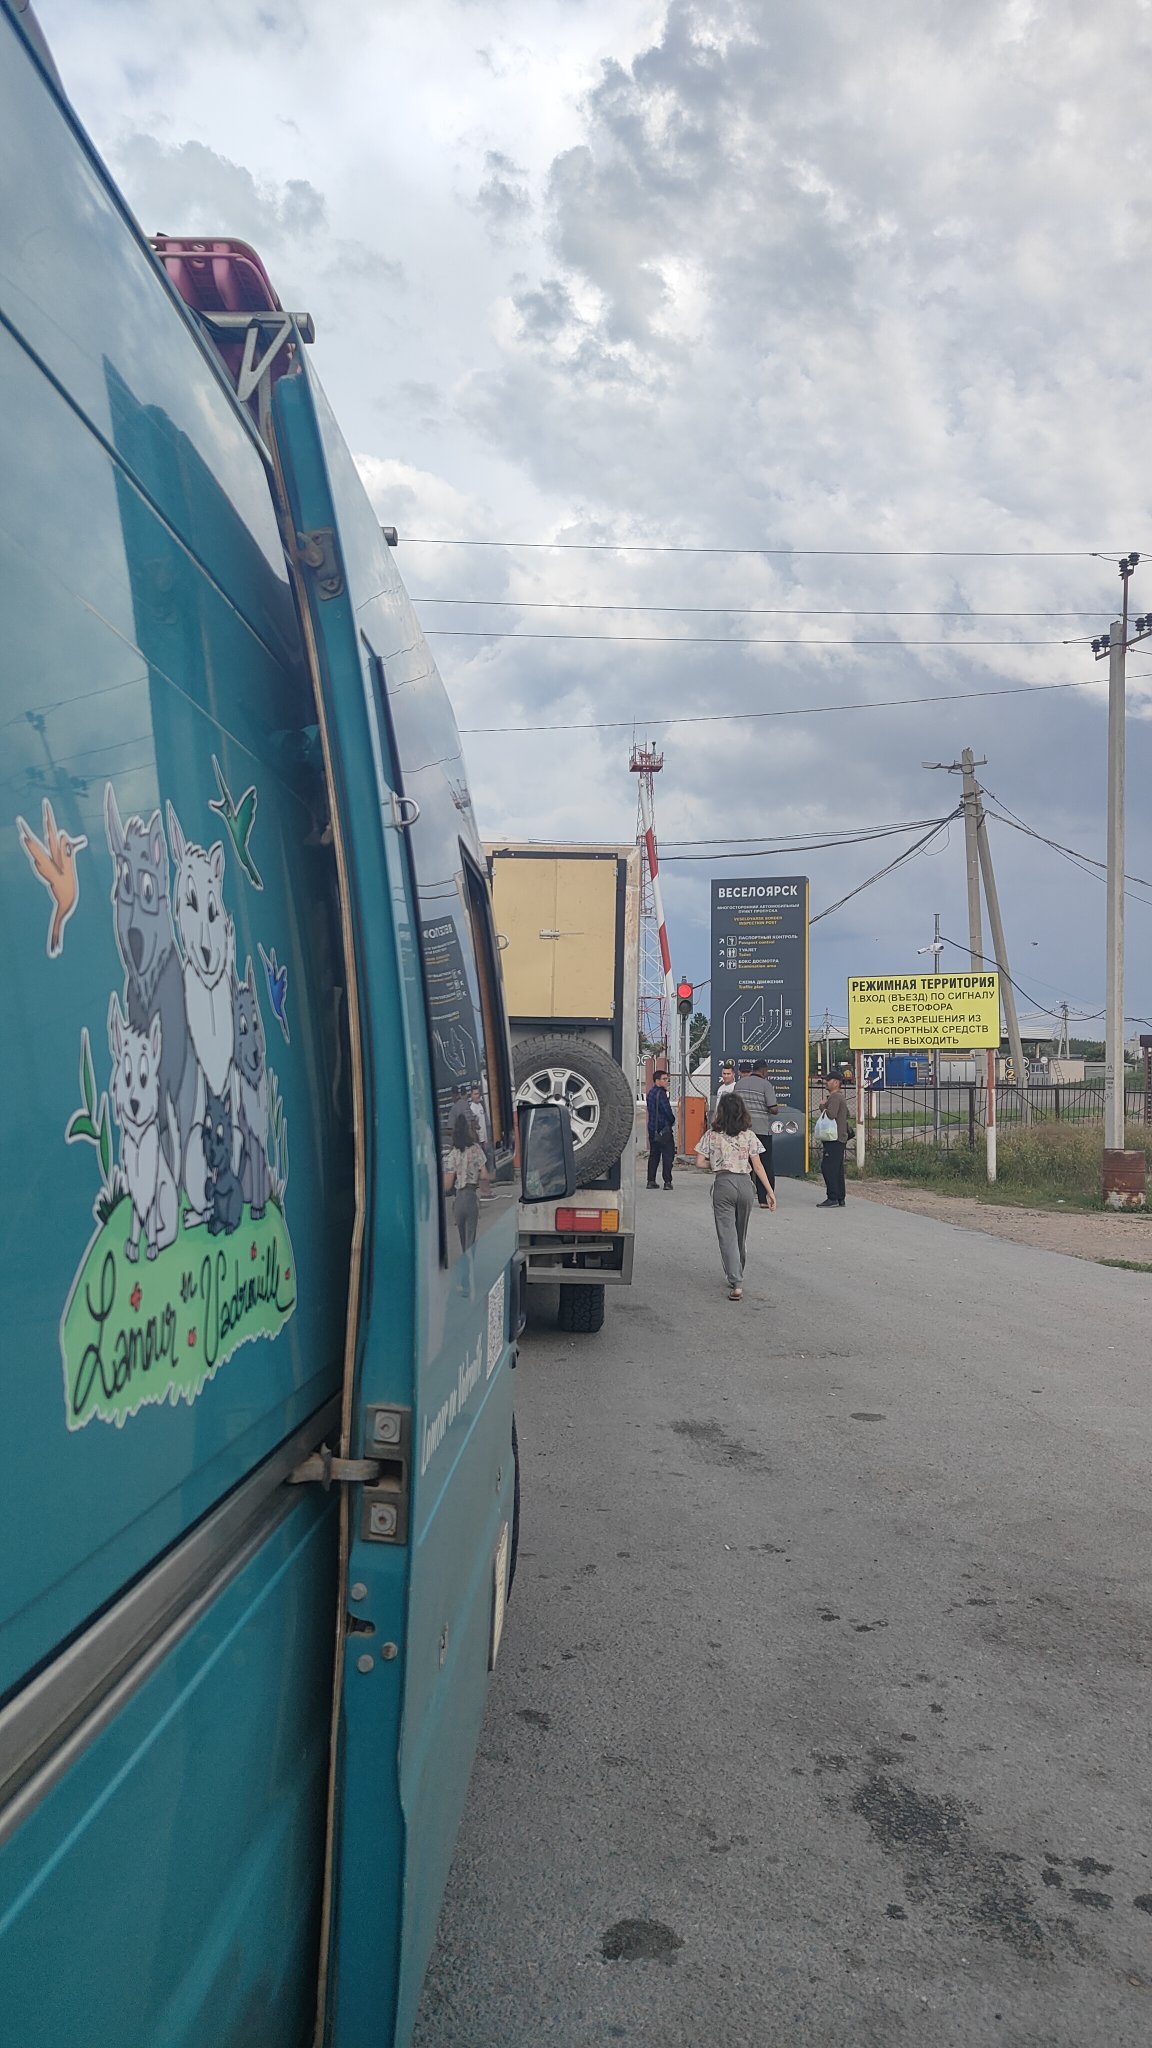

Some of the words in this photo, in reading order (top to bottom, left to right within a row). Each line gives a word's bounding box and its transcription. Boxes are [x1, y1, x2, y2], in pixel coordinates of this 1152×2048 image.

[718, 885, 798, 898] ВЕСЕЛОЯРСК
[852, 979, 917, 992] РЕЖИМНАЯ
[921, 976, 995, 990] ТЕРРИТОРИЯ
[852, 994, 886, 1003] 1.ВХОД
[888, 993, 928, 1003] (ВЪЕЗД)
[931, 993, 945, 1001] ПО
[948, 991, 995, 1000] СИГНАЛУ
[892, 1003, 953, 1012] СВЕТОФОРА
[866, 1016, 873, 1025] 2.
[876, 1016, 894, 1024] БЕЗ
[897, 1015, 965, 1023] РАЗРЕШЕНИЯ
[969, 1014, 981, 1022] ИЗ
[859, 1026, 939, 1035] ТРАНСПОРТНЫХ
[942, 1025, 989, 1034] СРЕДСТВ
[887, 1037, 900, 1045] НЕ
[903, 1036, 959, 1046] ВЫХОДИТЬ
